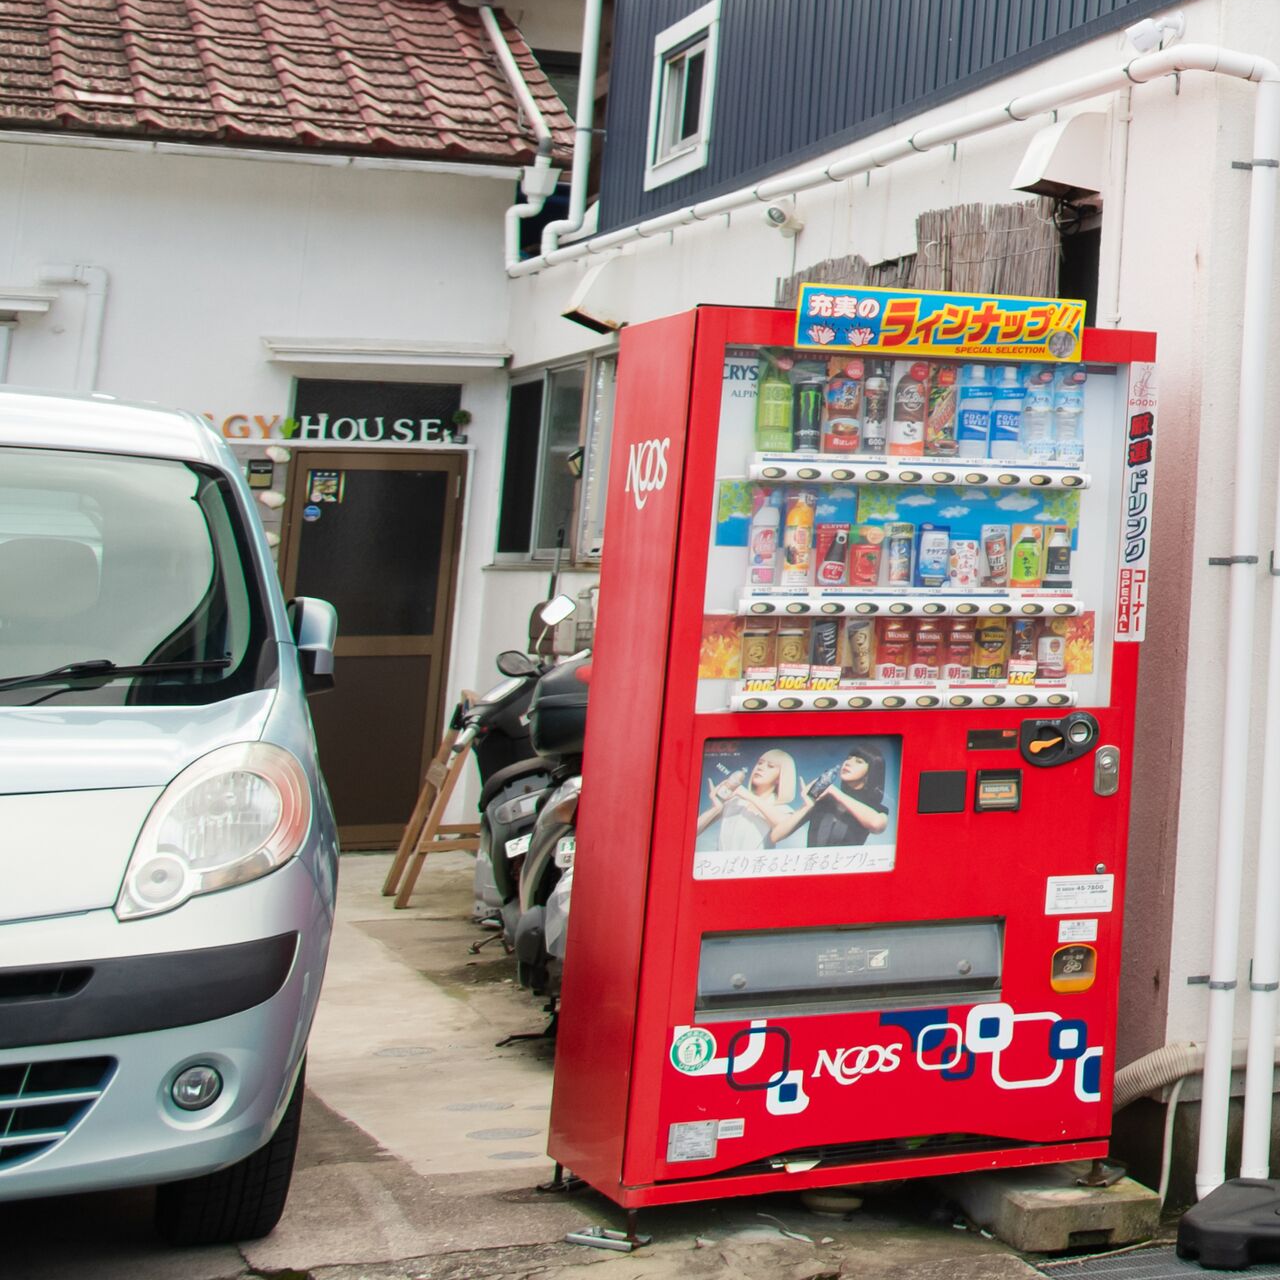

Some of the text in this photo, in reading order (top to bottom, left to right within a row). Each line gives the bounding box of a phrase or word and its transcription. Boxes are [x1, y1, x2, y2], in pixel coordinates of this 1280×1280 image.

[808, 294, 881, 320] 充実の
[955, 346, 1046, 355] SPECIAL SELECTION
[204, 412, 442, 444] GY HOUSE
[1117, 570, 1132, 632] SPECIAL
[1132, 570, 1146, 632] コーナー
